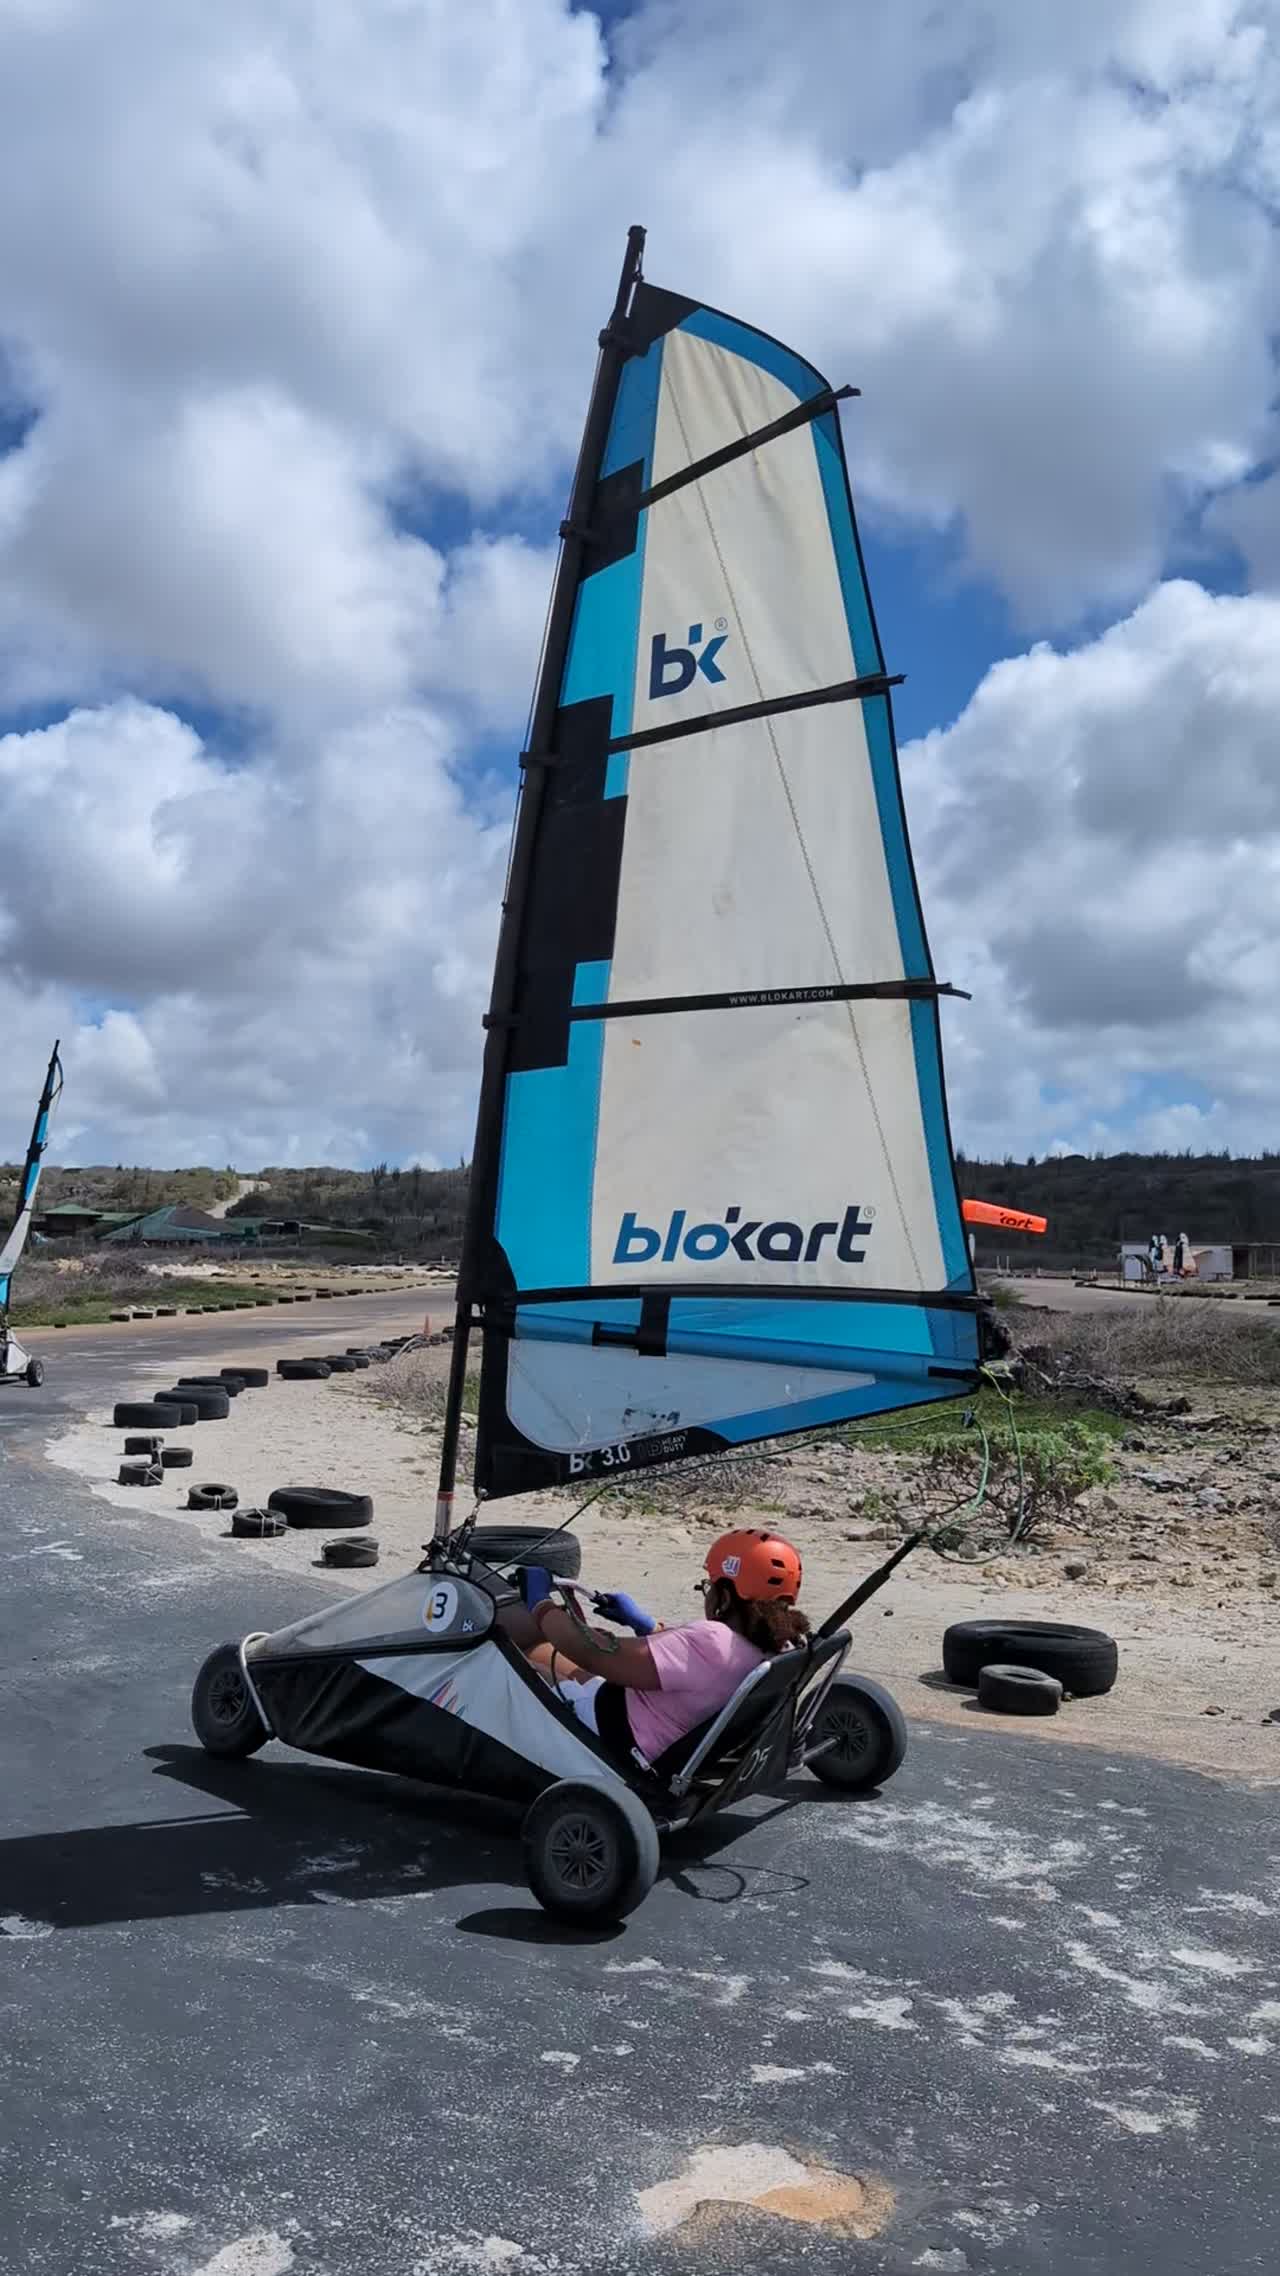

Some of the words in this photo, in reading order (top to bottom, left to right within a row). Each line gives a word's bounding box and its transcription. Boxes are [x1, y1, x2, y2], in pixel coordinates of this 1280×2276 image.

[728, 988, 835, 1005] WWW.BLOKART.COM
[601, 1443, 631, 1467] 3.0
[432, 1592, 449, 1619] 3
